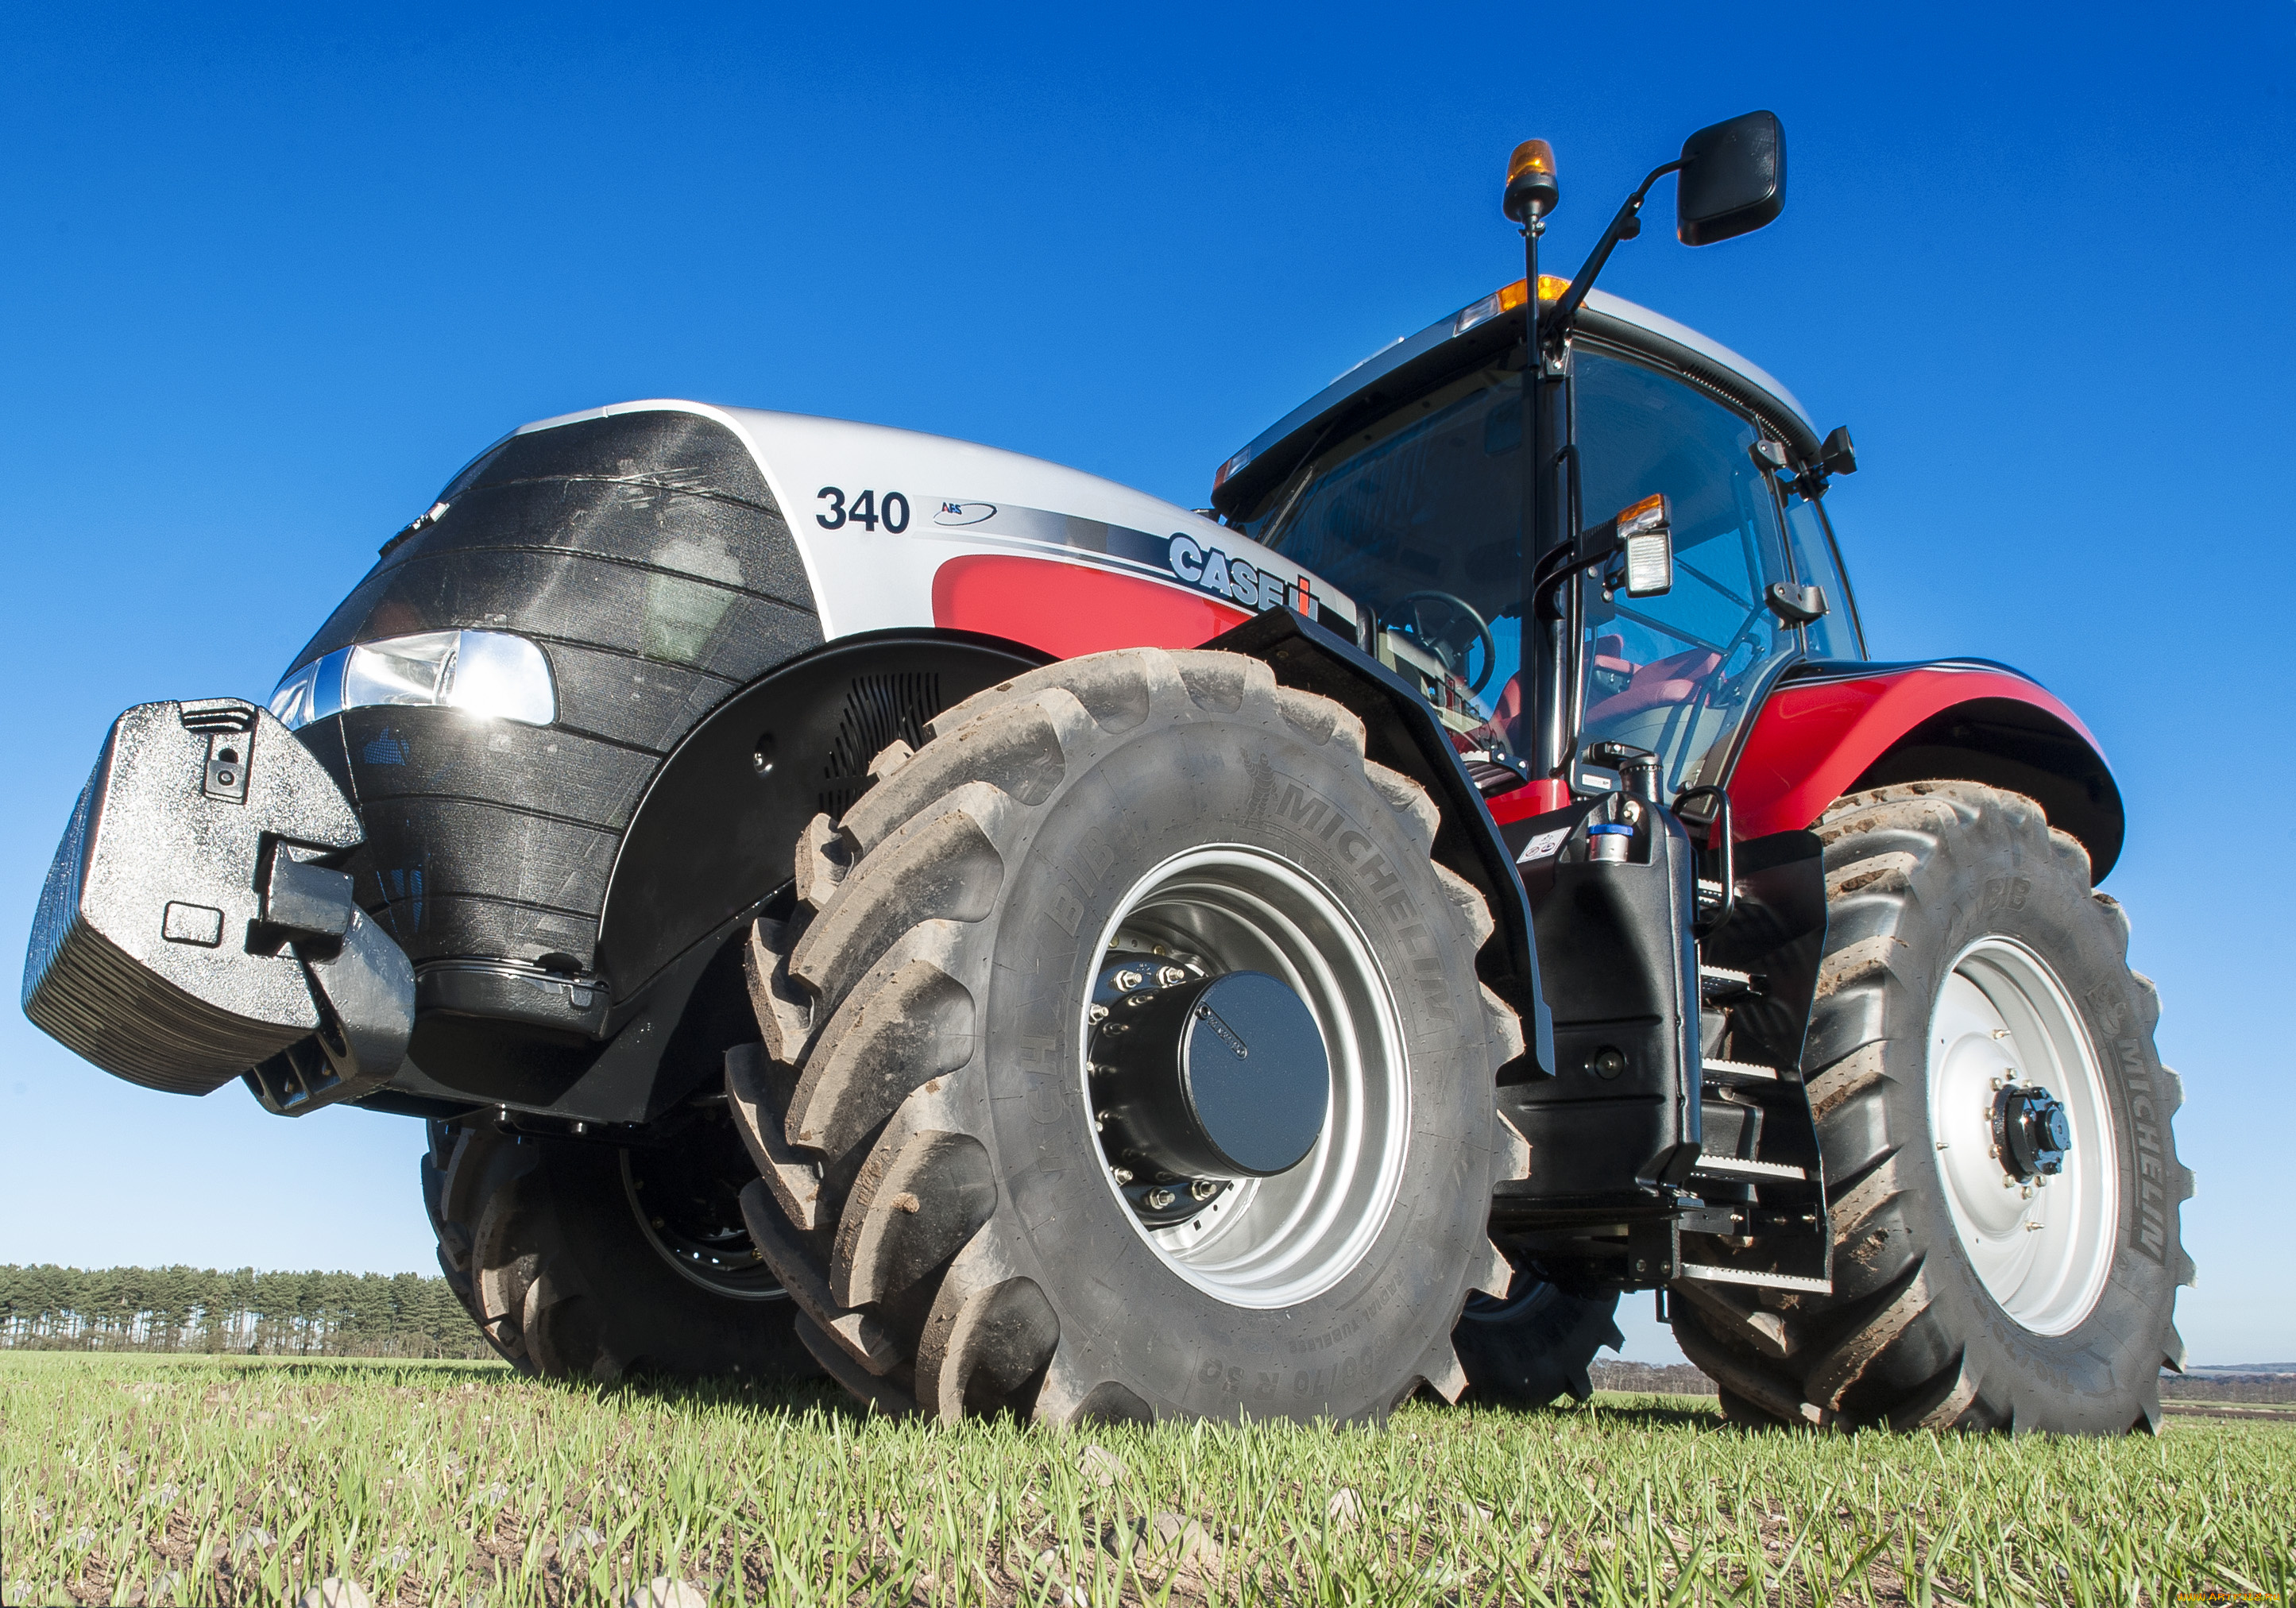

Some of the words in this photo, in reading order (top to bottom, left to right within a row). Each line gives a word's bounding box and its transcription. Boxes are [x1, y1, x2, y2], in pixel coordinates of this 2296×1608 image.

[815, 485, 910, 535] 340
[1169, 536, 1284, 612] CASE
[1044, 826, 1114, 938] BIB
[1275, 782, 1455, 1022] MICHELIN
[2116, 1038, 2165, 1260] MICHELIN
